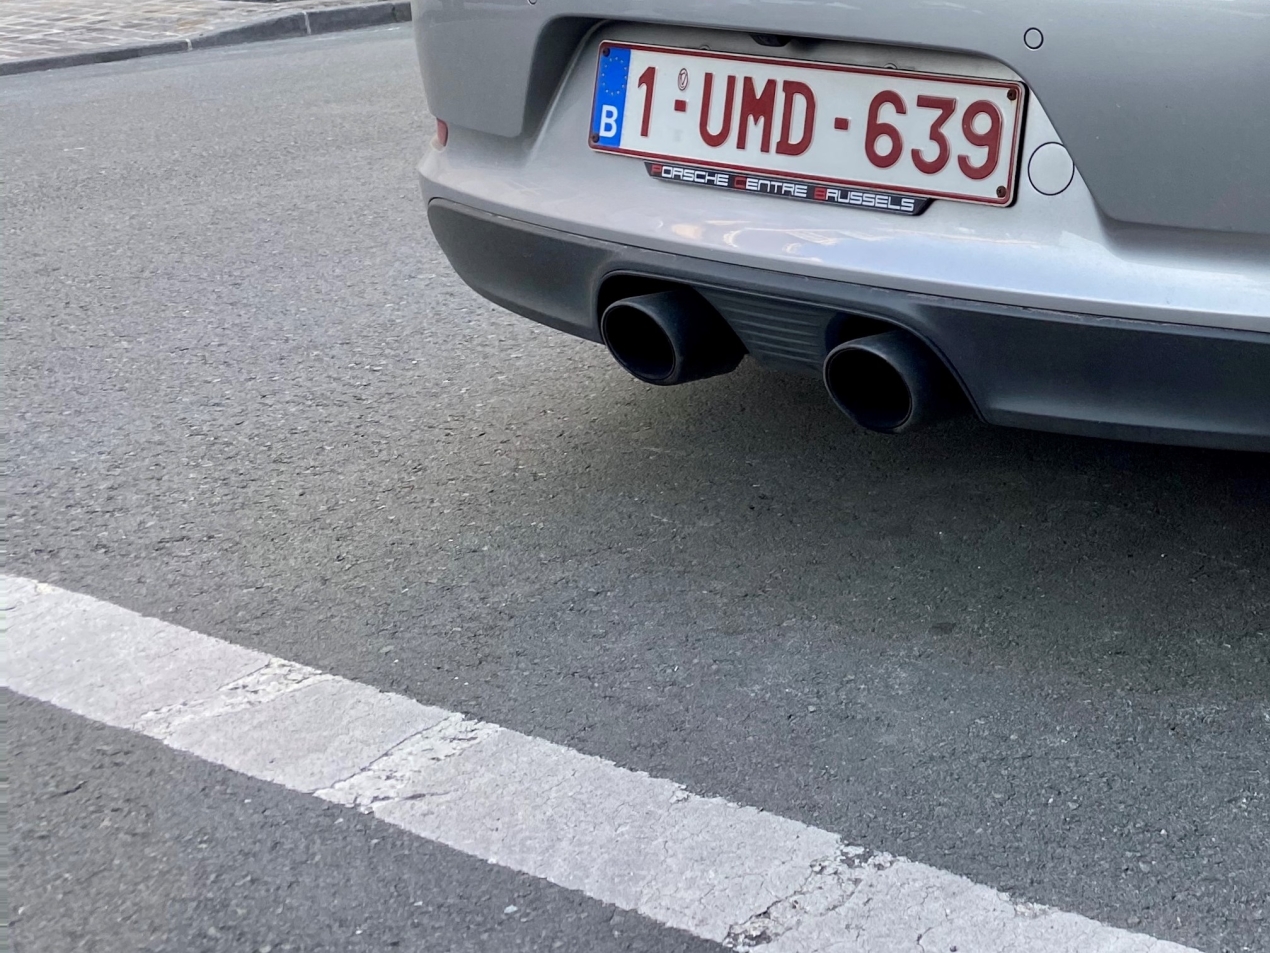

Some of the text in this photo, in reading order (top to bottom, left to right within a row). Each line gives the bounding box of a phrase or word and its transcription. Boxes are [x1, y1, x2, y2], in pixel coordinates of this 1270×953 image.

[599, 104, 618, 138] B
[638, 66, 1003, 180] 1-UMD-639
[651, 164, 915, 212] PORSCHE CENTRE BRUSSELS
